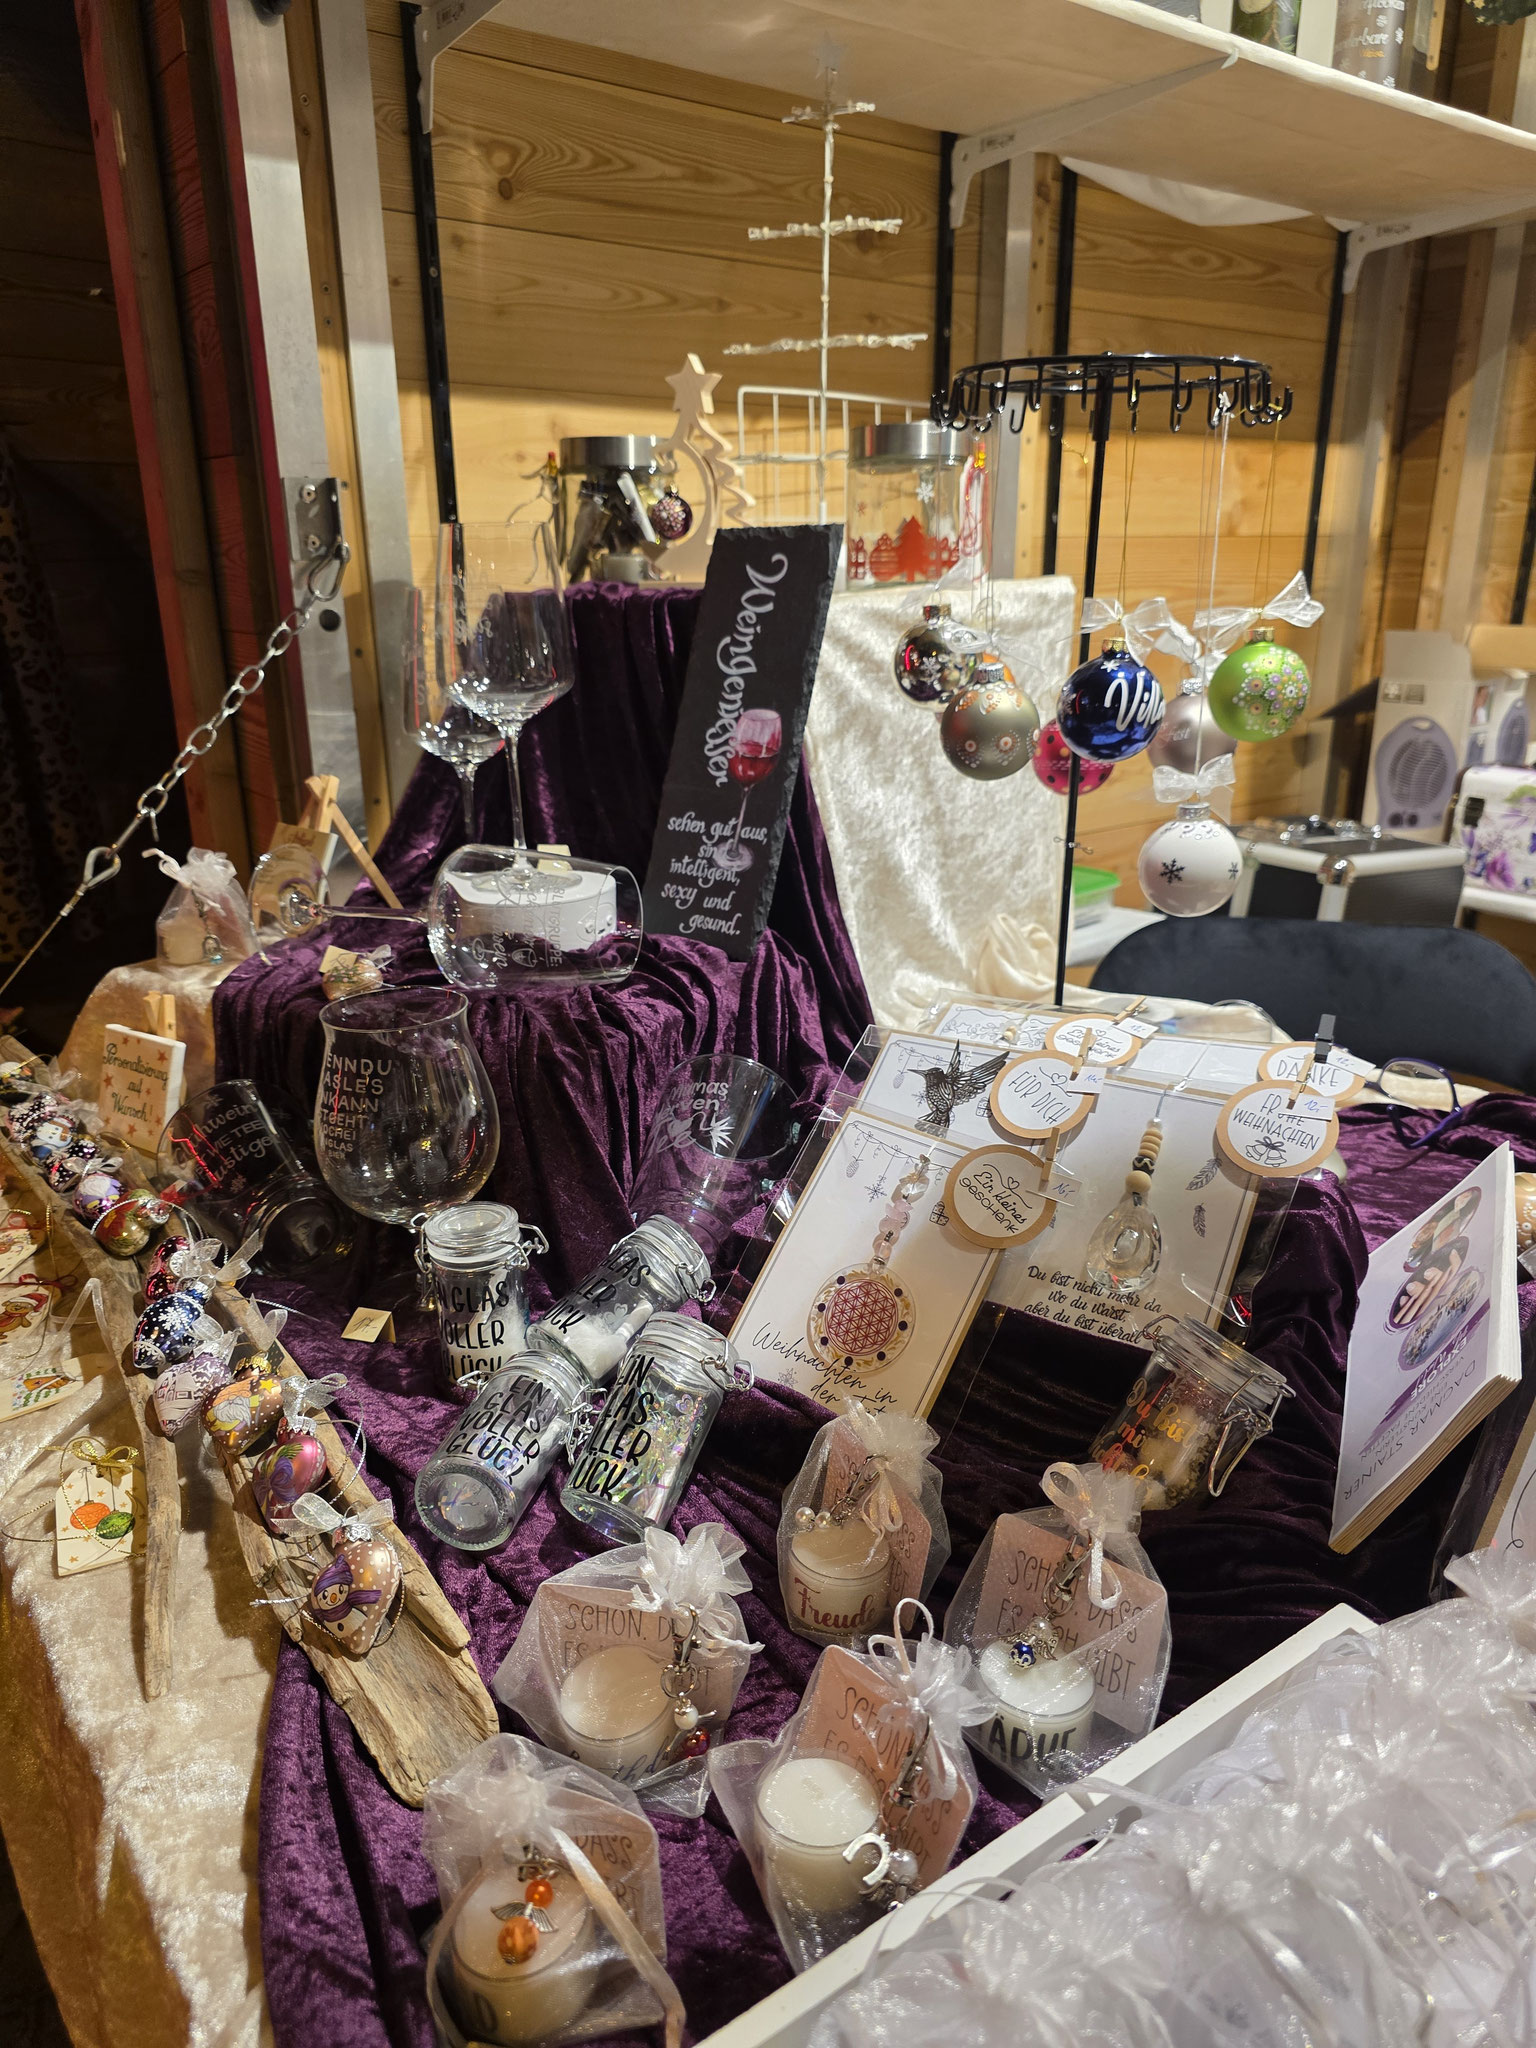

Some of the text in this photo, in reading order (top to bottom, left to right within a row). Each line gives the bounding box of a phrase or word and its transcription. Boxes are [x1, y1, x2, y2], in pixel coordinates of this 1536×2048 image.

[667, 811, 768, 844] sehen gut aus,
[669, 855, 741, 889] intelligent,
[660, 881, 736, 912] sexy und
[679, 912, 742, 935] gesund.
[360, 1058, 392, 1076] DU
[1008, 1071, 1071, 1125] FÜR DICH
[230, 1118, 265, 1138] TEE
[1232, 1107, 1320, 1151] WEIHNACHTEN
[973, 1171, 1028, 1225] Ein kleines
[450, 1280, 510, 1314] GLAS
[1027, 1265, 1163, 1314] Du bist nicht mehr da
[1070, 1295, 1088, 1311] du
[442, 1318, 505, 1350] OLLER
[1024, 1301, 1145, 1345] aber du bist überall
[444, 1354, 503, 1383] LÜCK
[752, 1321, 898, 1404] Weihnachten in
[1411, 1336, 1468, 1401] EXPLORE
[509, 1373, 552, 1407] EIN
[1126, 1377, 1151, 1419] Du
[484, 1391, 547, 1435] GLAS
[1343, 1359, 1477, 1501] DAGMAR STAINER
[445, 1432, 526, 1486] GLÜCK
[459, 1410, 541, 1466] VOLLER
[794, 1577, 876, 1630] Freude
